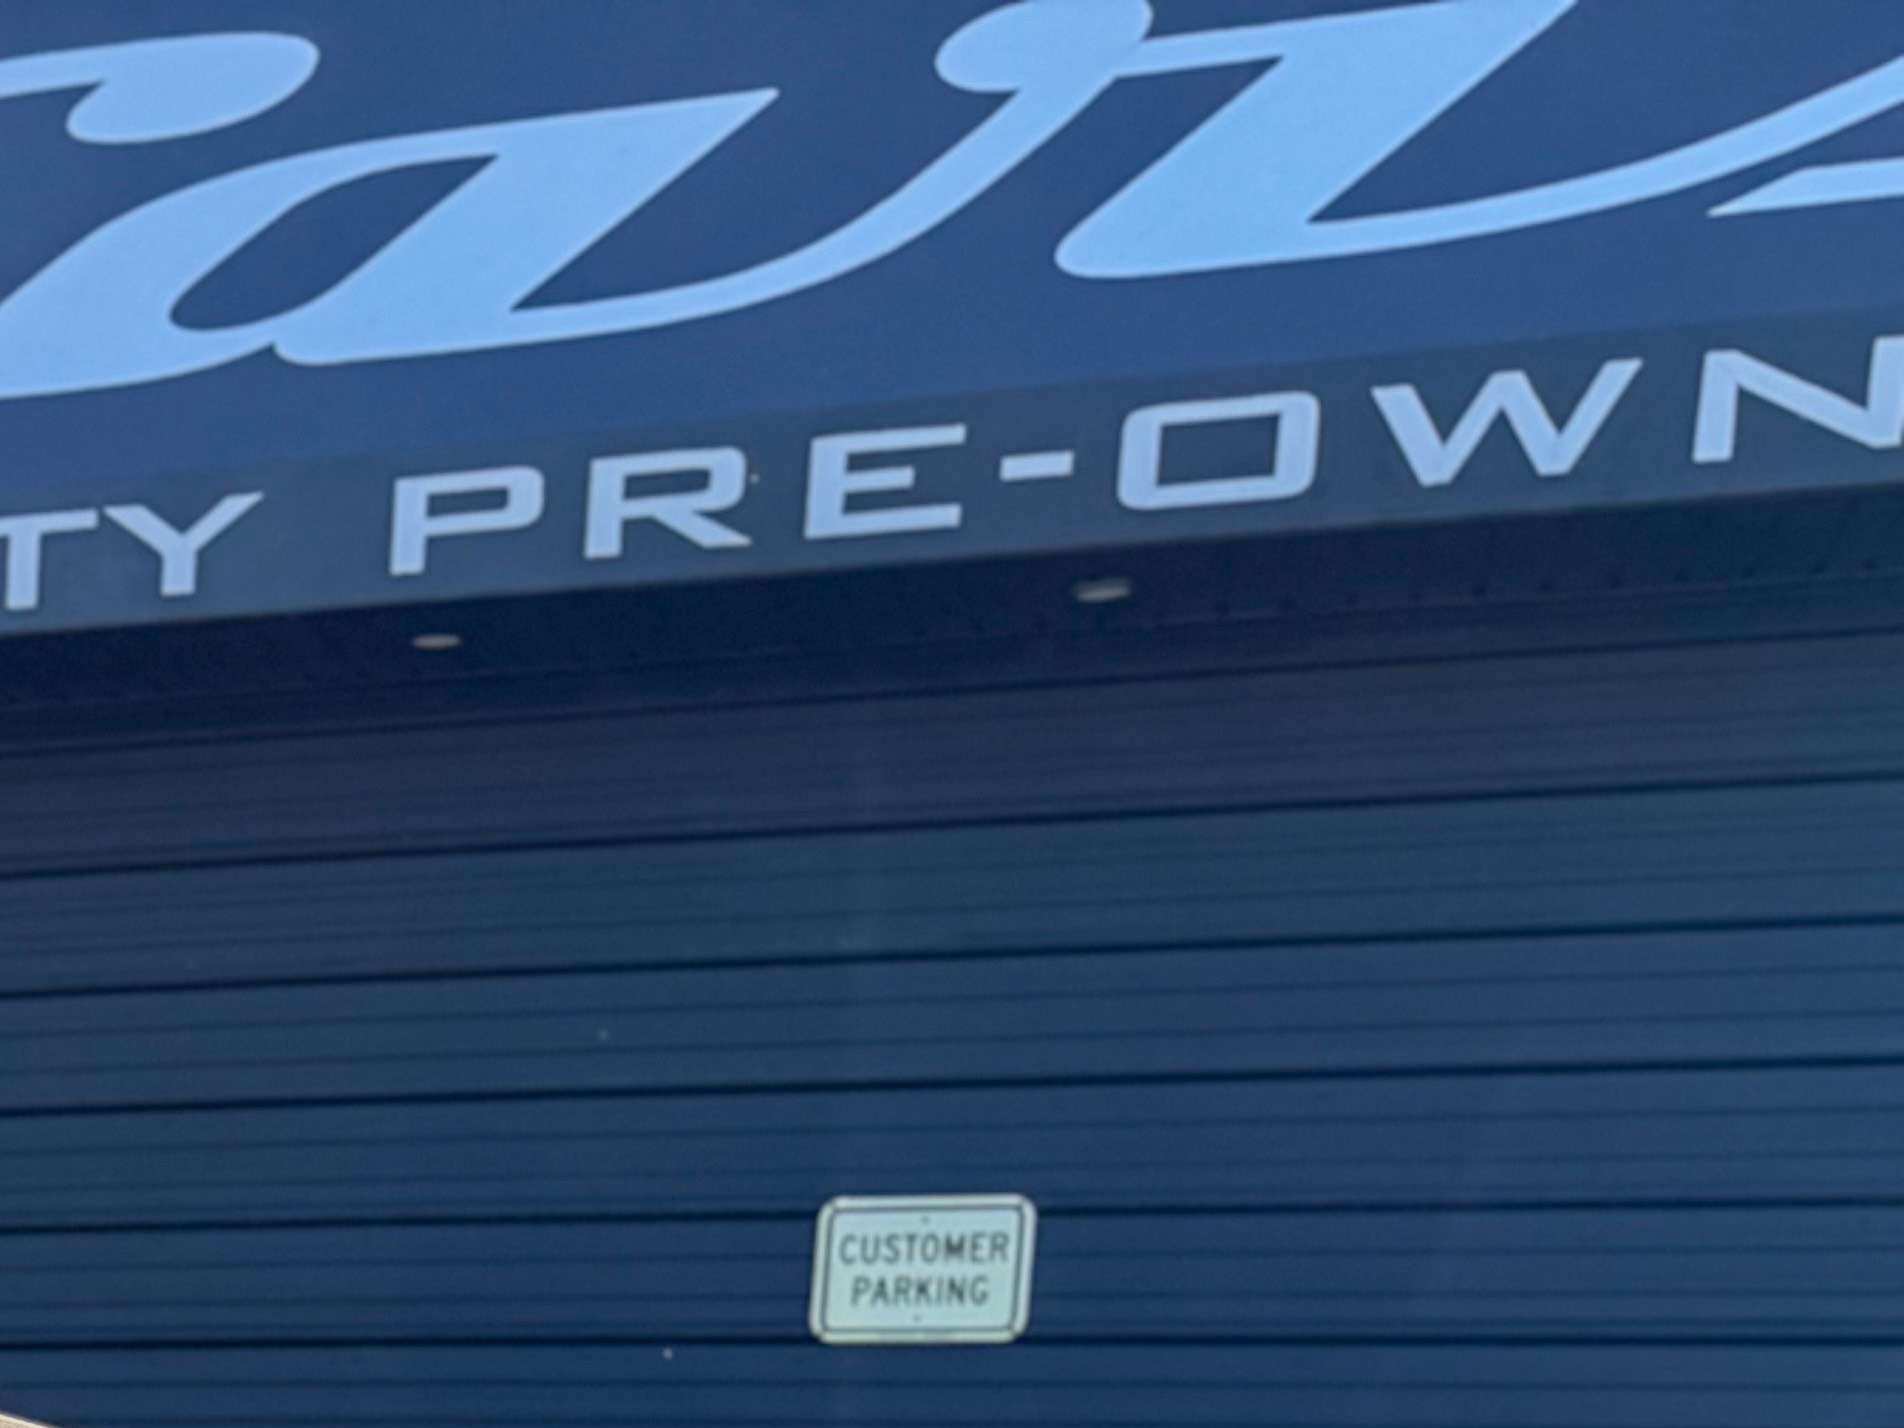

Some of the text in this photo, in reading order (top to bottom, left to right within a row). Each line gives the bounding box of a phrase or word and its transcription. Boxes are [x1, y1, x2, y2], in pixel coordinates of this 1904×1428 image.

[389, 334, 1904, 577] PRE-OWN
[838, 1230, 1011, 1267] CUSTOMER
[849, 1274, 991, 1308] PARKING
